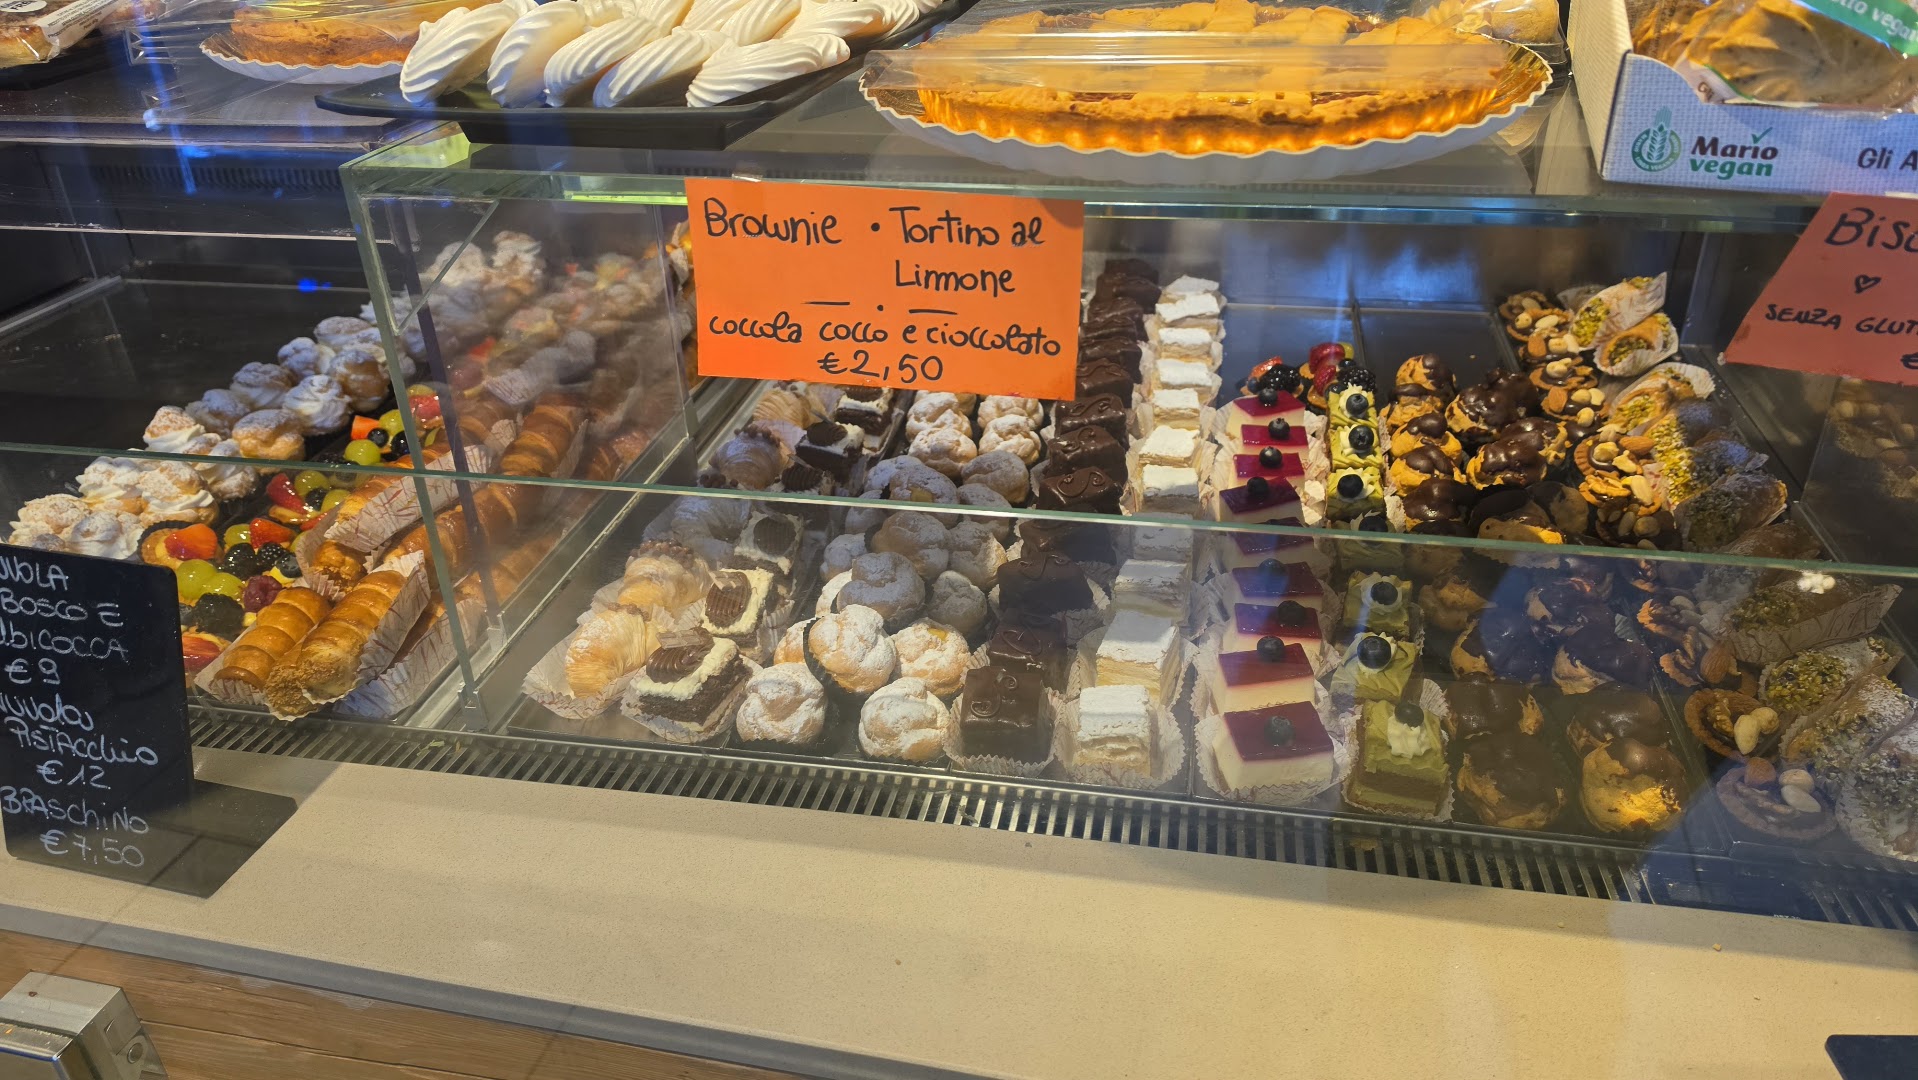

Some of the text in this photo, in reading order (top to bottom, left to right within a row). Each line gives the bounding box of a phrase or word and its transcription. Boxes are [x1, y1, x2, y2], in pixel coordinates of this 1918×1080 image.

[1691, 135, 1778, 160] Mario
[1857, 147, 1894, 169] Gli
[1690, 158, 1773, 180] vegan
[703, 197, 842, 246] Brownie
[889, 206, 1000, 245] Tortino
[1765, 303, 1842, 331] SENZA
[708, 311, 1062, 357] coccola cocco e cioccolato
